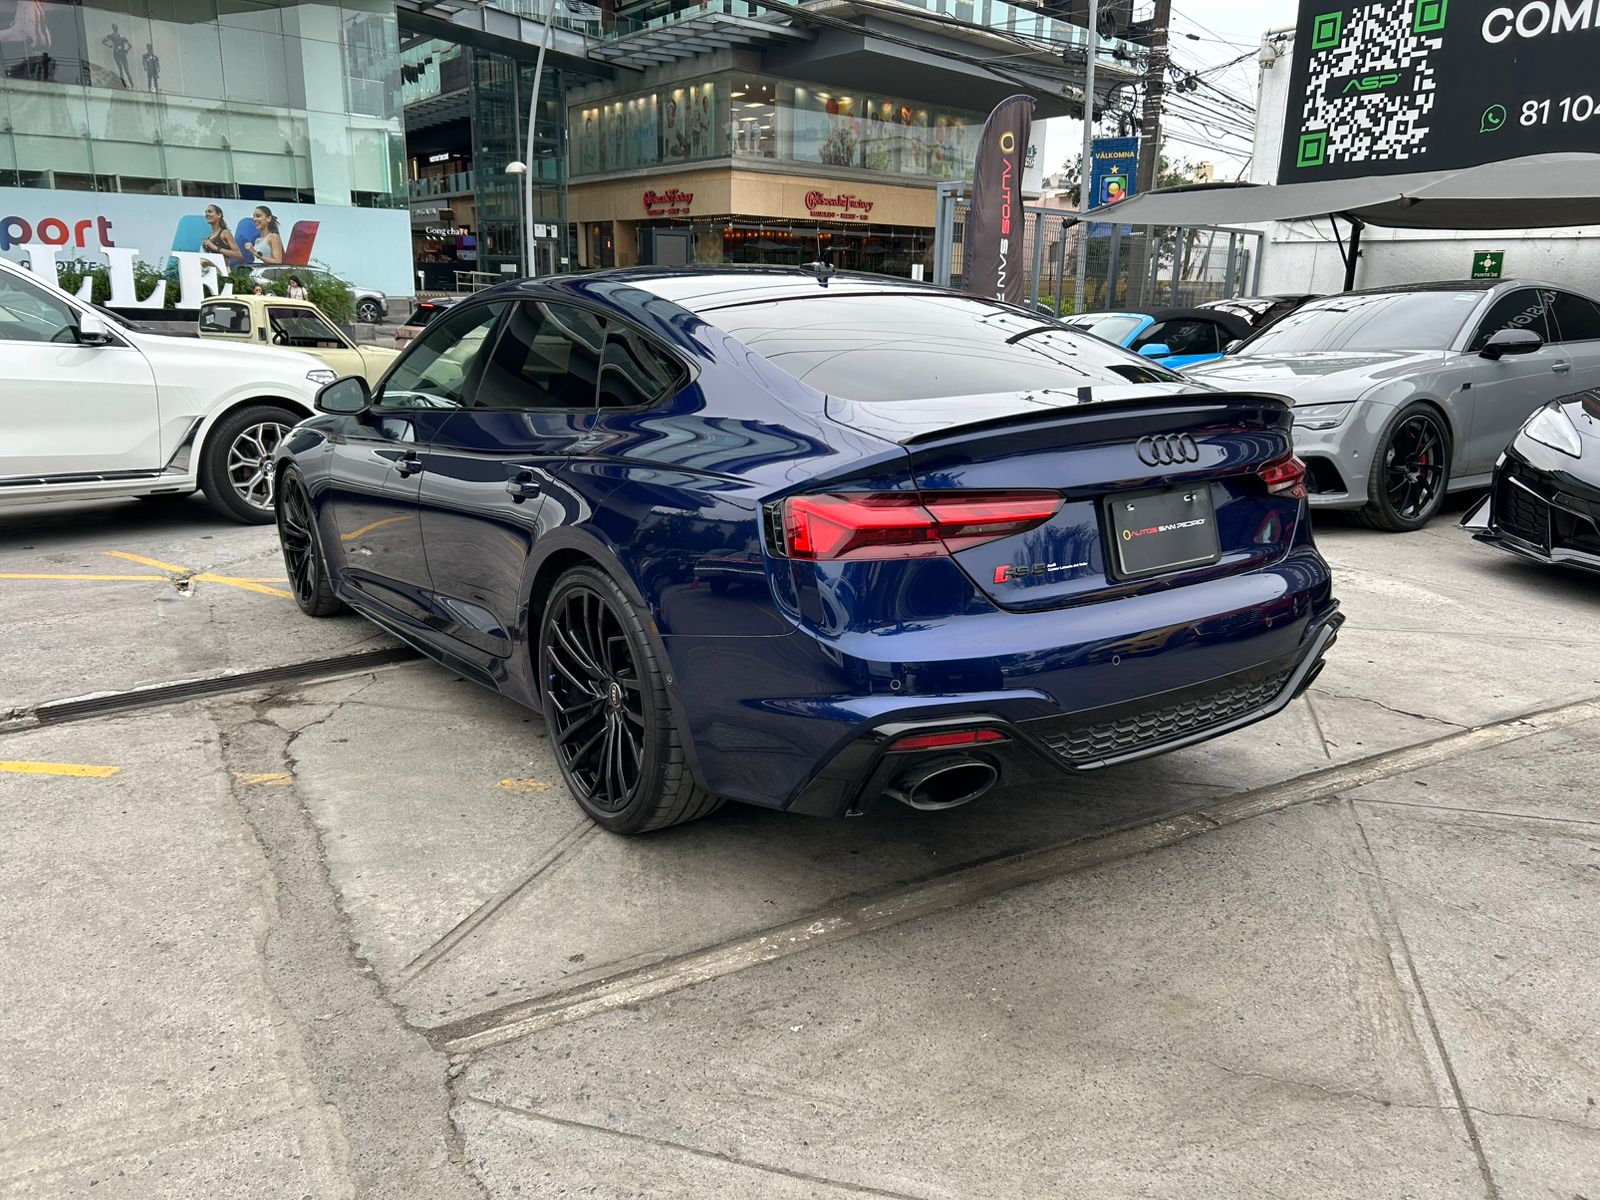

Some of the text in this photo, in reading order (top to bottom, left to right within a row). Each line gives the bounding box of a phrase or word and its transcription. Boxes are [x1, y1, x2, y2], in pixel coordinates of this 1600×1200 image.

[1481, 0, 1600, 44] COM
[1342, 74, 1399, 93] ASP
[1520, 95, 1600, 126] 81 10
[1002, 158, 1012, 235] AUTOS
[0, 216, 114, 250] port
[425, 226, 447, 236] Gong
[997, 238, 1009, 288] SAN
[1132, 528, 1158, 537] AUTOS
[1158, 524, 1176, 532] SAN
[1032, 563, 1045, 576] 5
